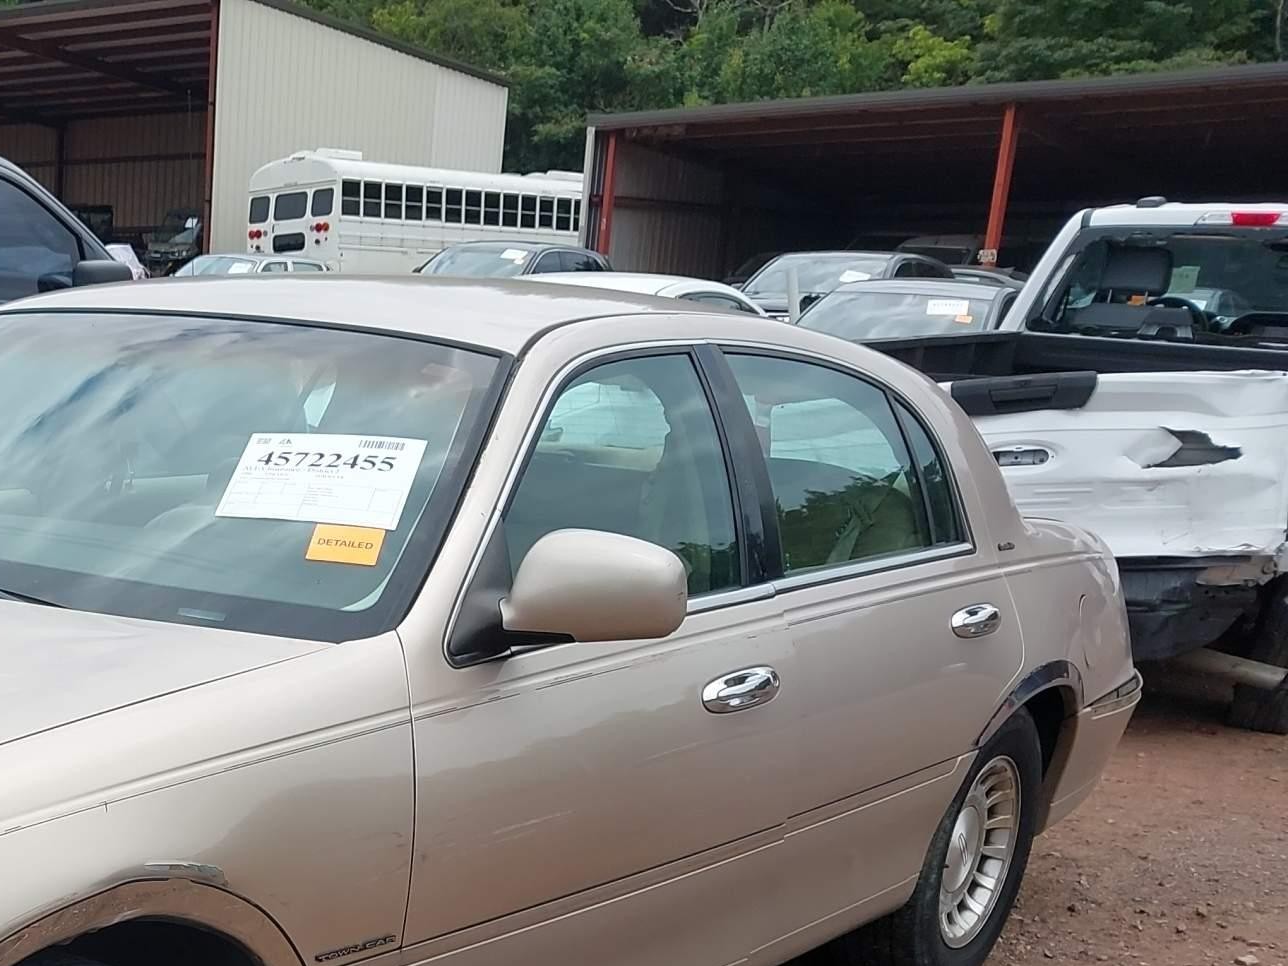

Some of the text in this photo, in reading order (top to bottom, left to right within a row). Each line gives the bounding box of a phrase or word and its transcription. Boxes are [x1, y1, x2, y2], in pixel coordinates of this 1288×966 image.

[257, 450, 397, 472] 45722455
[317, 537, 374, 550] DETAILED
[316, 944, 361, 961] TOWN
